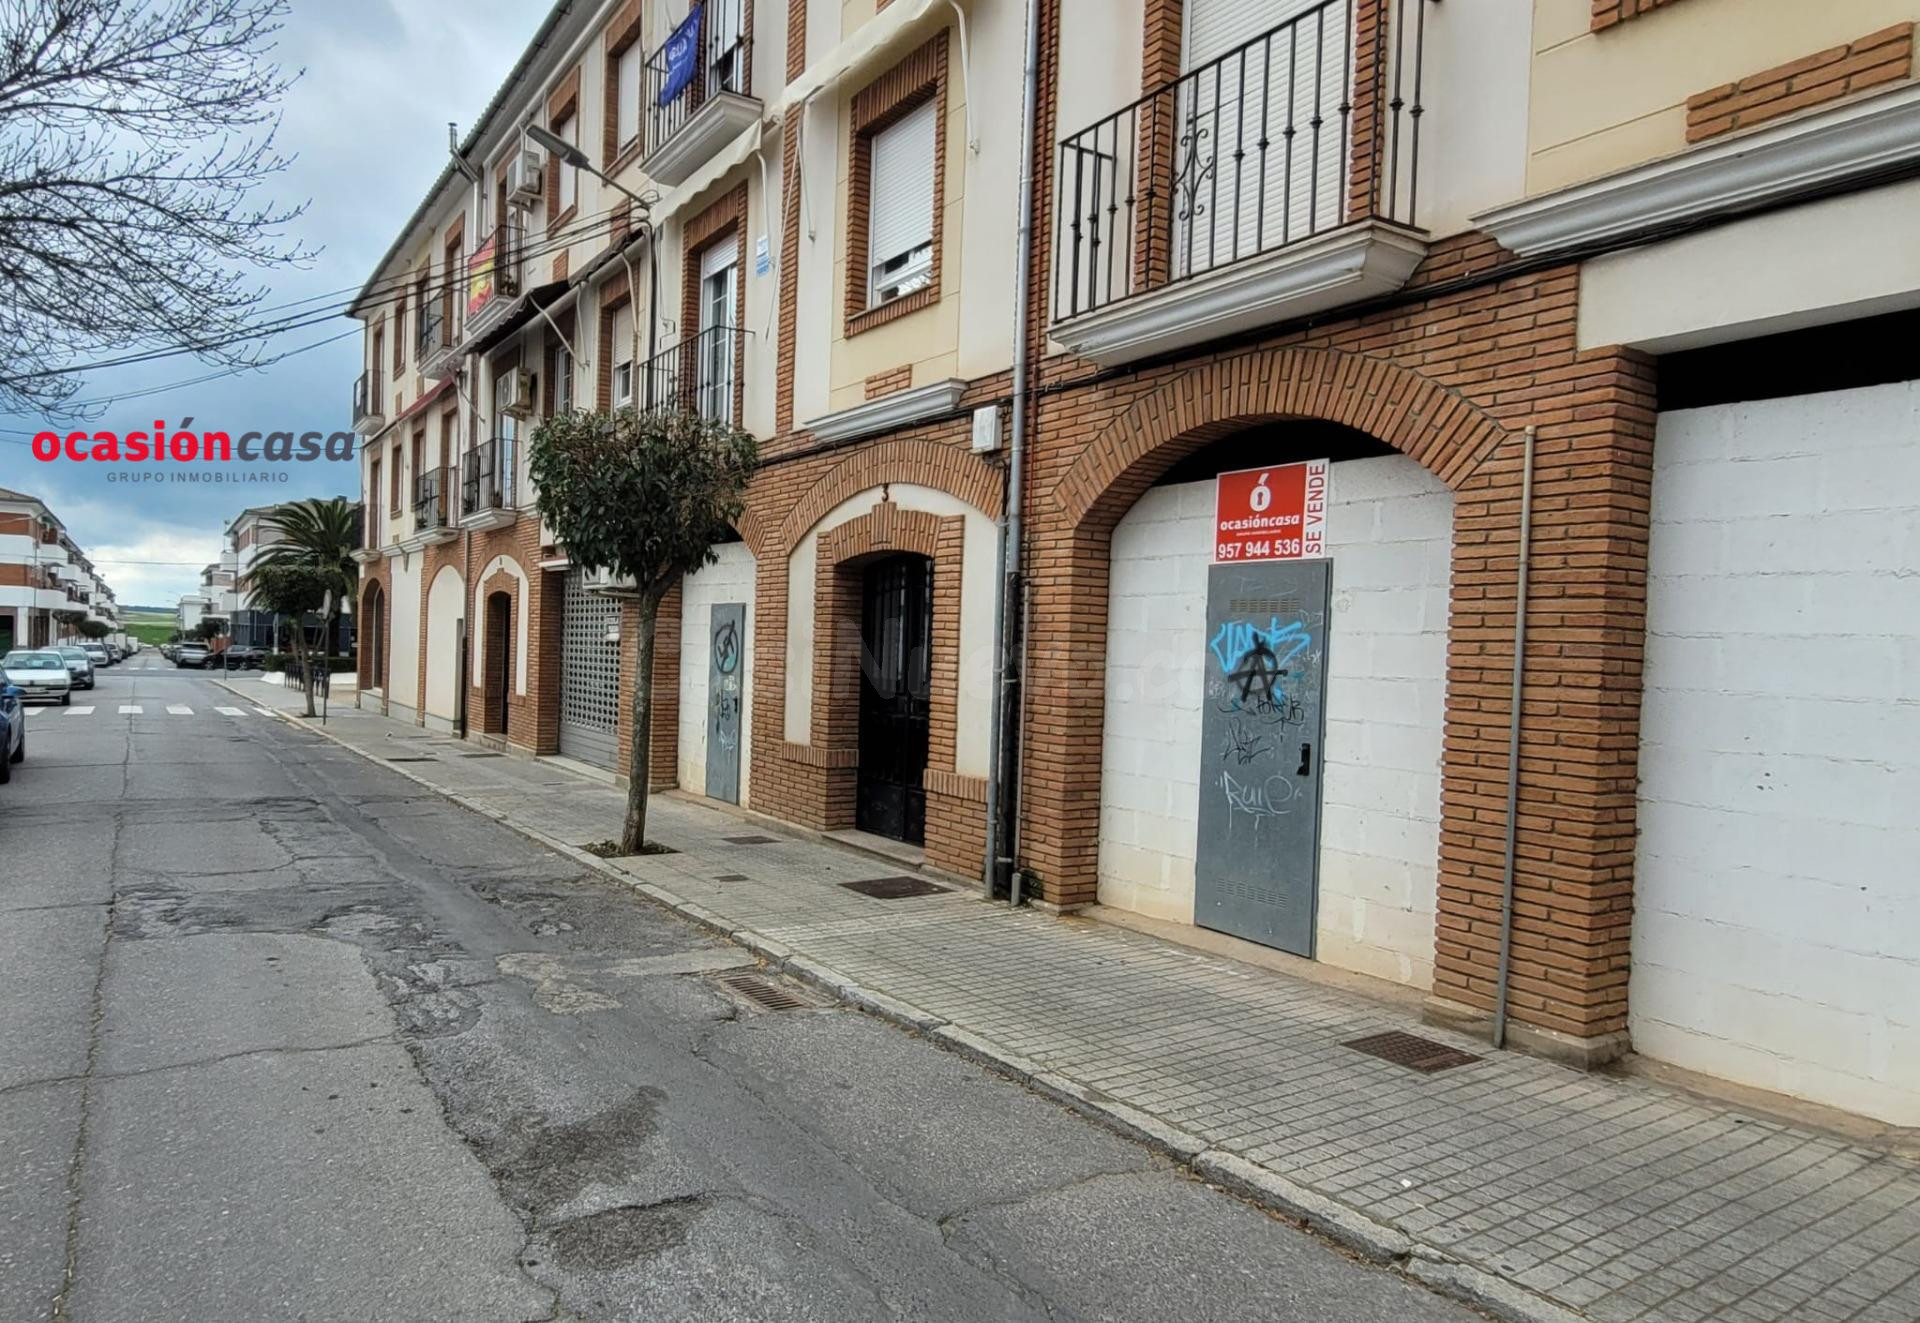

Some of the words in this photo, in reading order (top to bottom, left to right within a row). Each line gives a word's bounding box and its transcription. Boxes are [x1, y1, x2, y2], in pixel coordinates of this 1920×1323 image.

[1307, 463, 1326, 526] VENDE
[1220, 513, 1301, 531] ocasióncasa
[1218, 542, 1242, 559] 957
[1245, 540, 1270, 557] 944
[1274, 538, 1300, 556] 536
[1306, 531, 1322, 554] SE
